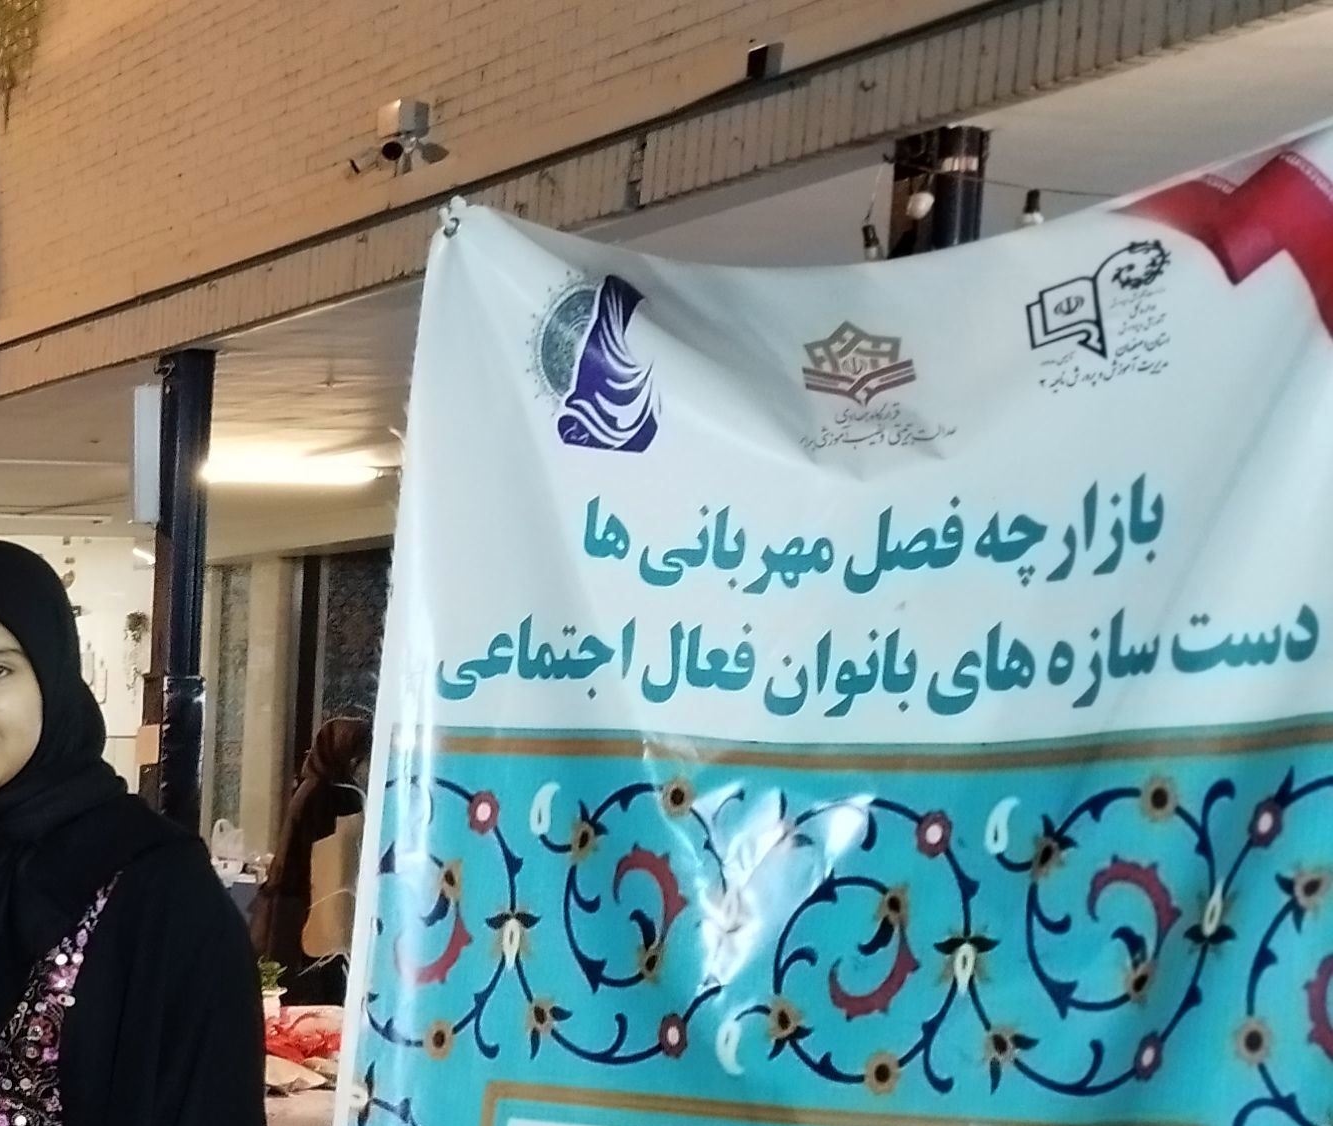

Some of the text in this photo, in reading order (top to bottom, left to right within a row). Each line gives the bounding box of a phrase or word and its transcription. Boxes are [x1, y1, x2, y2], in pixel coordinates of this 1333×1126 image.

[585, 496, 631, 563] ها
[639, 505, 834, 594] مهربانی
[845, 496, 963, 594] فصل
[436, 602, 1320, 718] دست سازه های بانوان فعال اجتماعی
